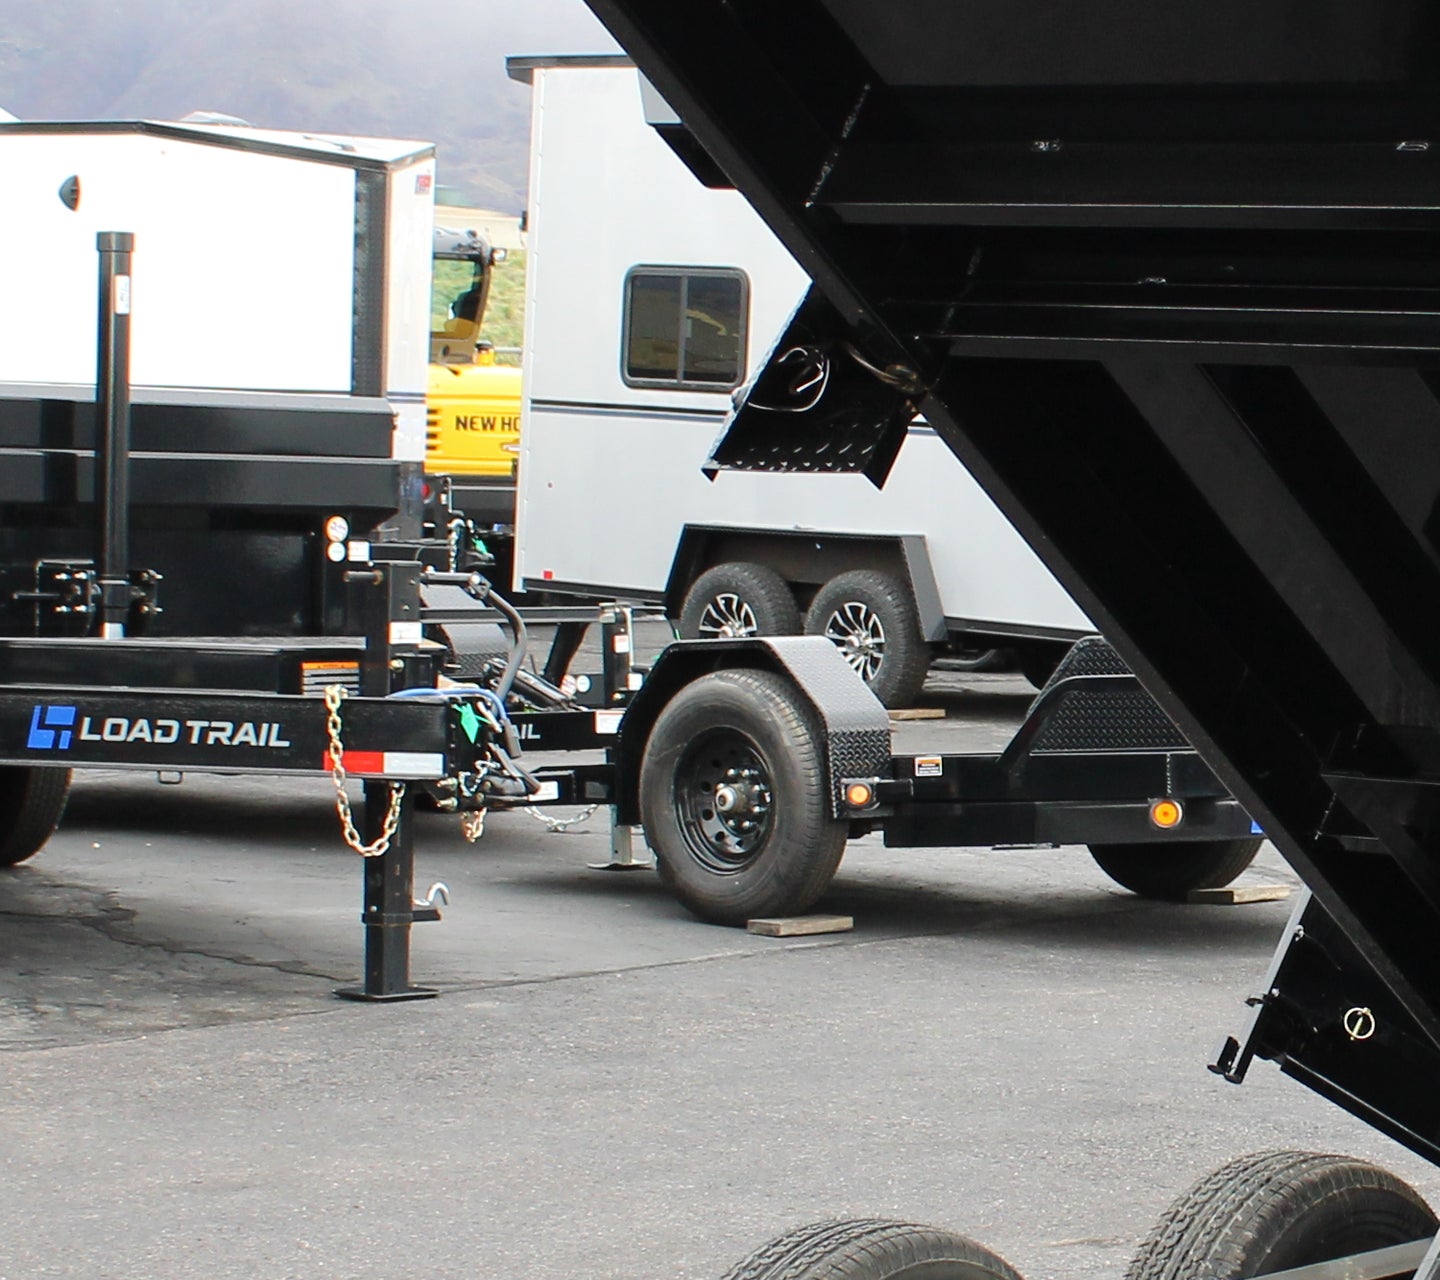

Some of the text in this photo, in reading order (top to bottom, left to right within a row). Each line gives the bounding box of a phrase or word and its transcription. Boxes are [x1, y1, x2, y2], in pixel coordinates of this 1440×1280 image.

[455, 415, 497, 431] NEW
[79, 716, 291, 747] LOAD TRAIL
